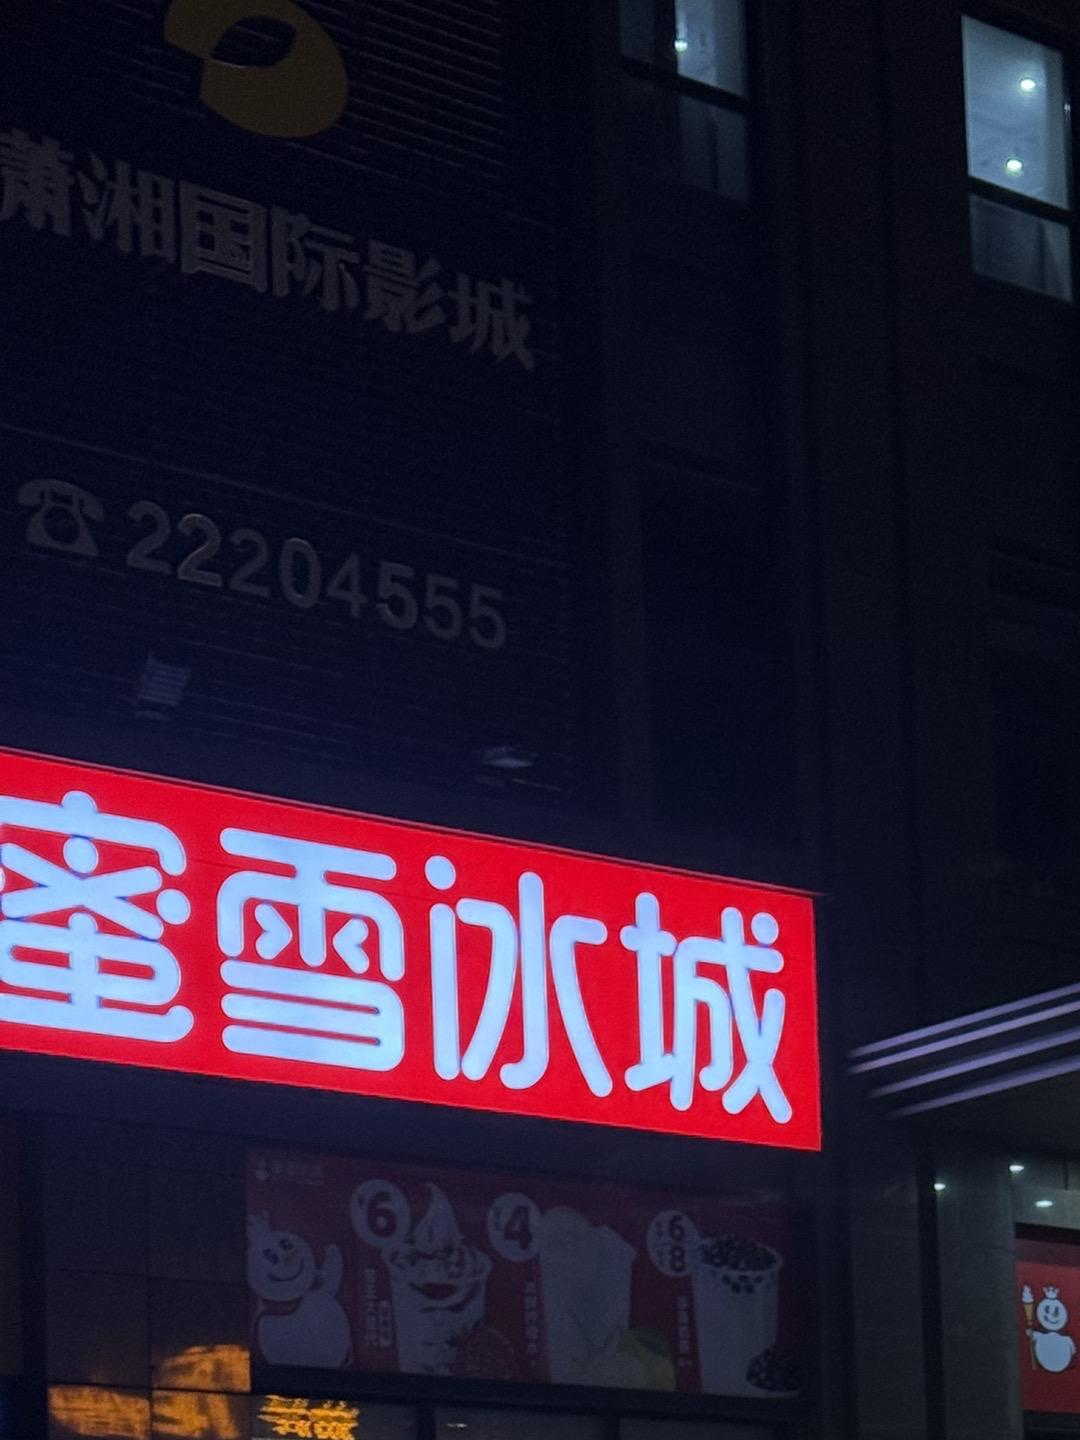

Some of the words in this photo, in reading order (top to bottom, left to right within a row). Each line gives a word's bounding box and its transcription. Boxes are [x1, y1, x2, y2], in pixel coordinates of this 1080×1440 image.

[125, 499, 508, 650] 22204555
[0, 790, 795, 1124] 蜜雪冰城
